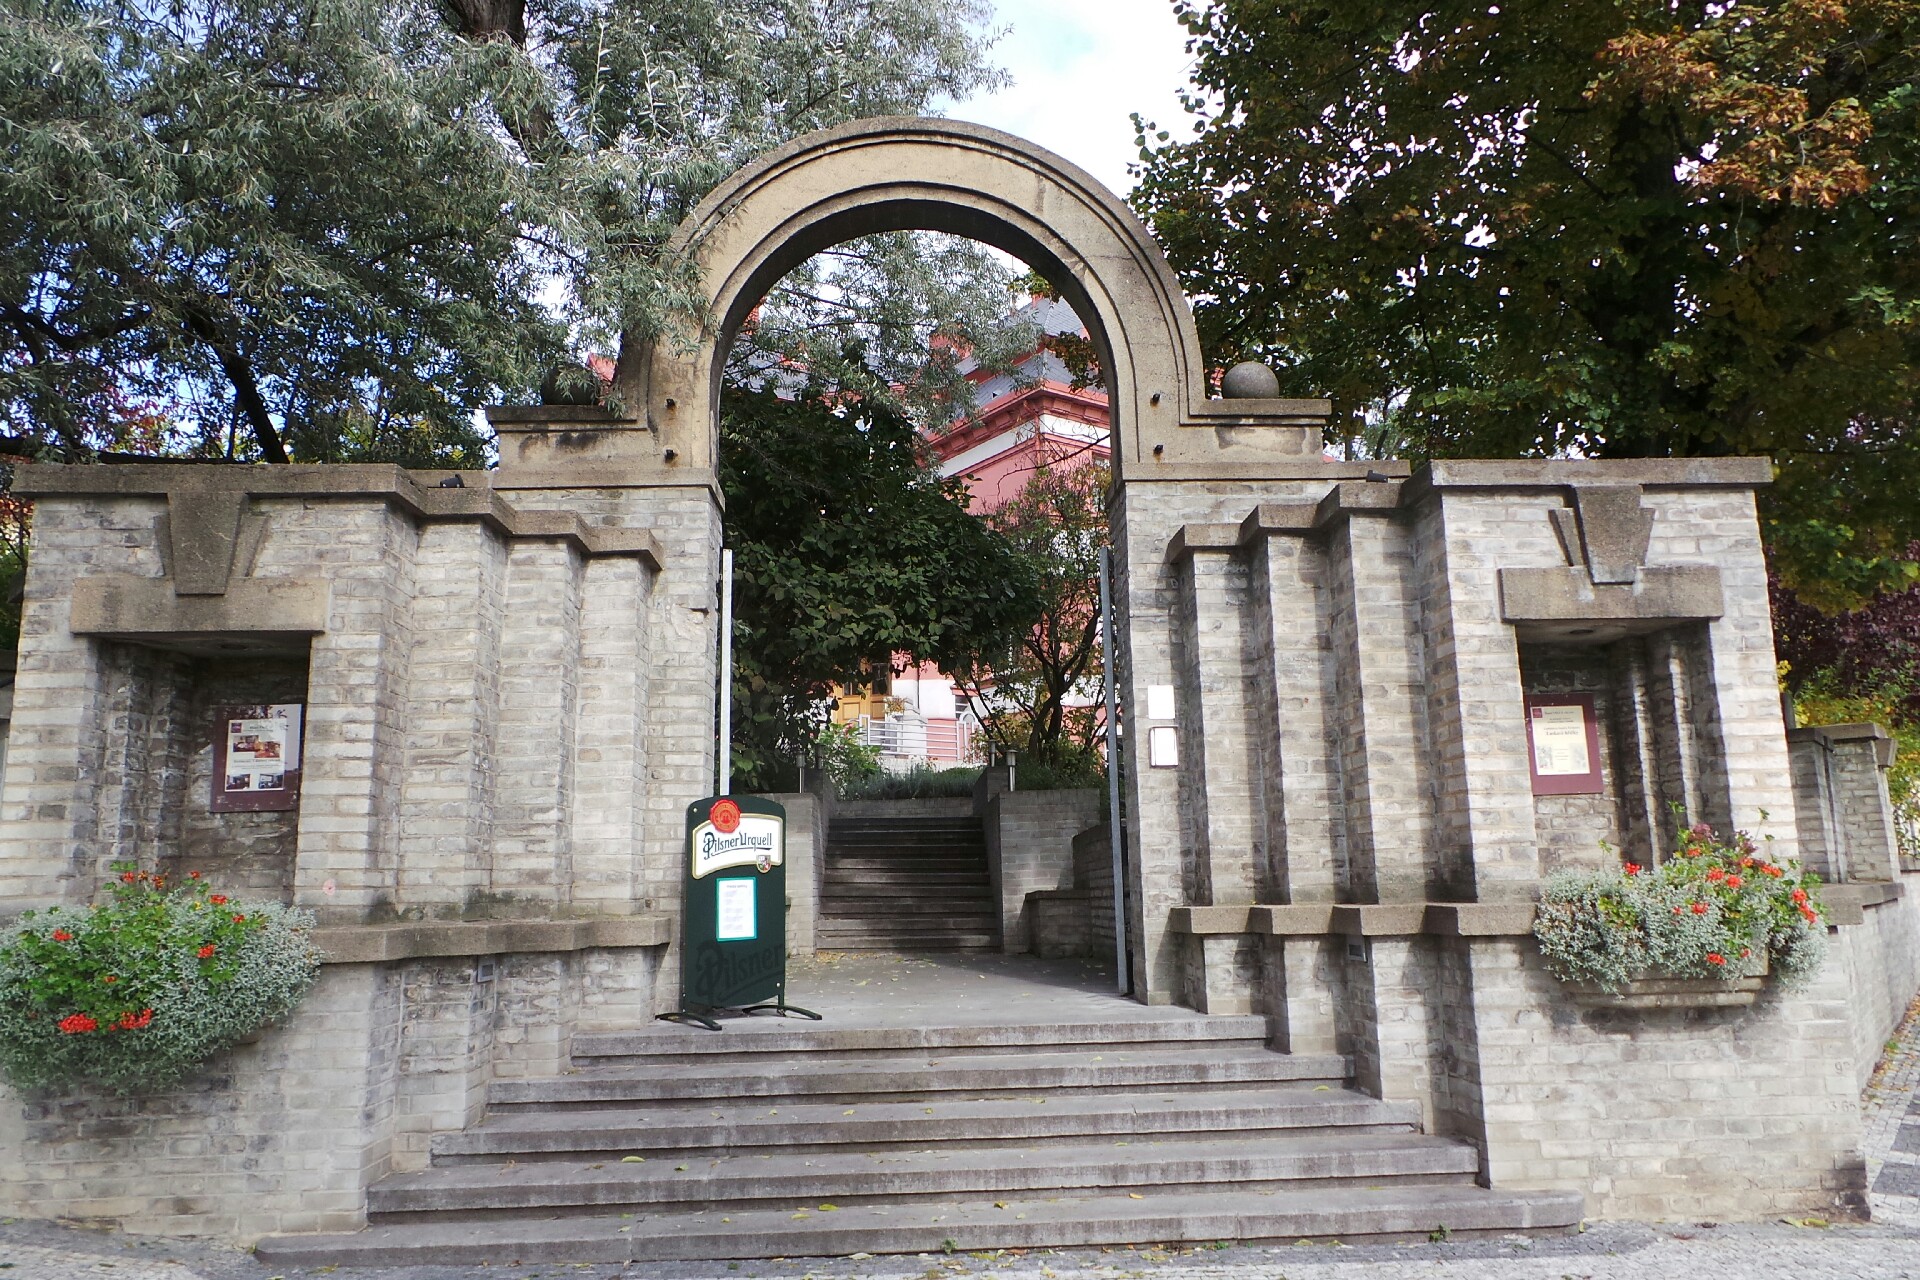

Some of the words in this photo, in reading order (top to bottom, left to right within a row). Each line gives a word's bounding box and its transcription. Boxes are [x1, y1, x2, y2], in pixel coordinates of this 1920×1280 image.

[703, 832, 739, 860] Pilsner
[739, 831, 772, 852] Urquell
[695, 940, 784, 1005] Pilsner
